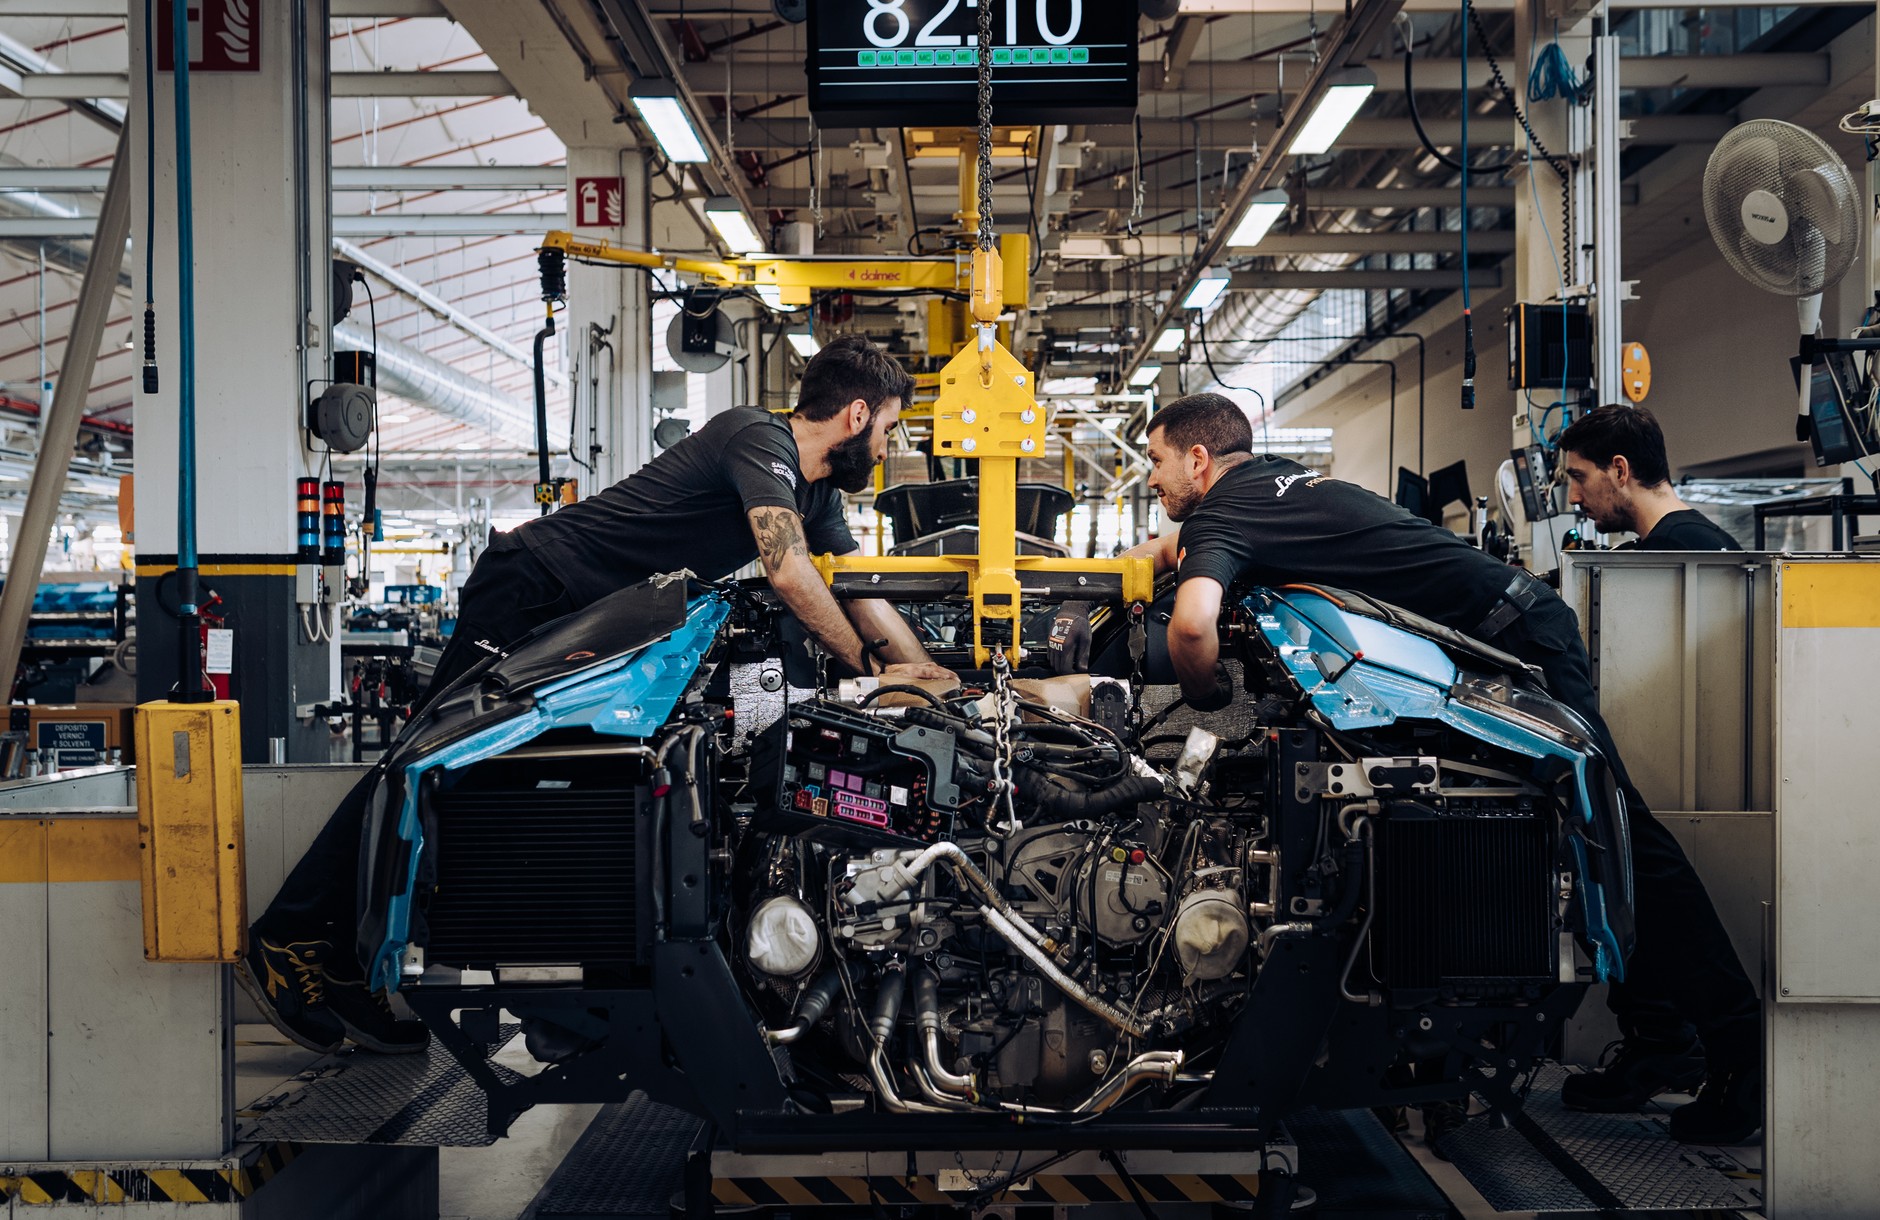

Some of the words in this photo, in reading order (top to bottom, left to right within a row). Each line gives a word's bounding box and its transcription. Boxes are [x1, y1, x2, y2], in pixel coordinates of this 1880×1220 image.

[860, 268, 901, 281] dalmec
[55, 724, 88, 732] DEPOSITO
[58, 732, 85, 740] VERNICI
[59, 740, 91, 748] SOLVENTI
